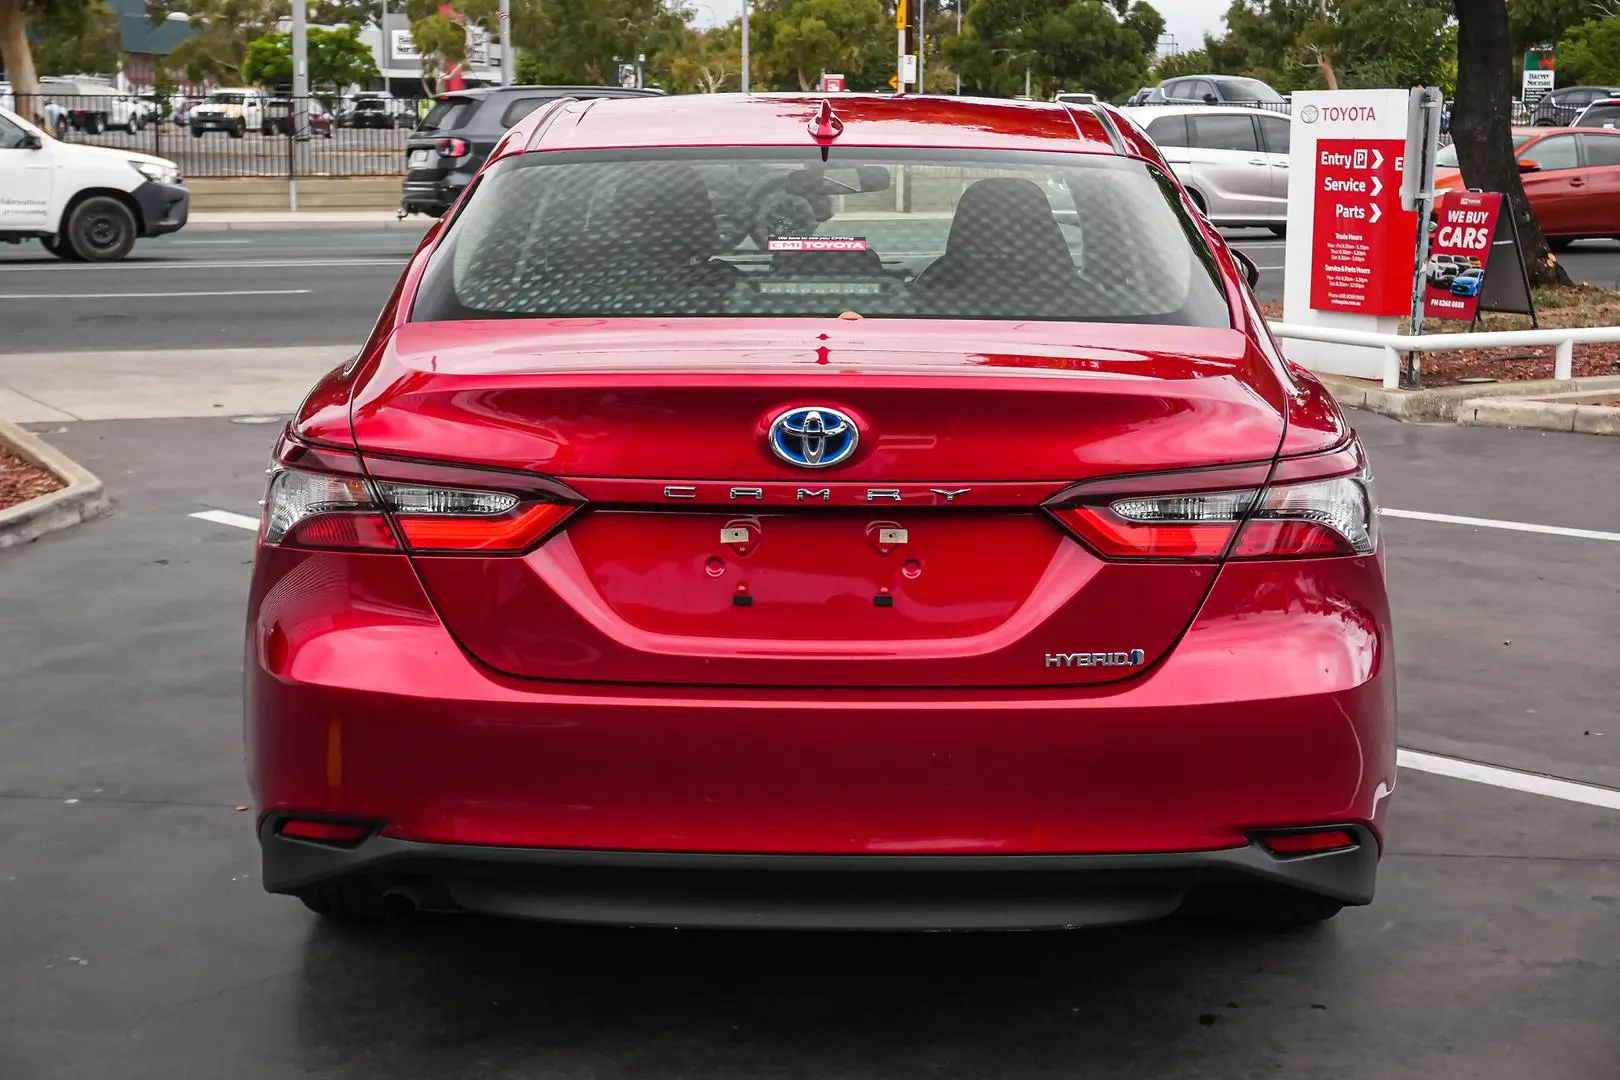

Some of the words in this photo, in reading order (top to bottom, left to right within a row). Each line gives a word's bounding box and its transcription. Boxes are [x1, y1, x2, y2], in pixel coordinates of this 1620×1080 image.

[1322, 107, 1376, 121] TOYOTA
[1321, 152, 1352, 169] Entry
[1324, 177, 1366, 192] Service
[1336, 204, 1365, 218] Parts
[1448, 210, 1464, 222] WE
[1466, 212, 1488, 224] BUY
[1438, 226, 1488, 250] CARS
[664, 486, 972, 501] CAMRY
[1046, 652, 1129, 668] HYBRID
